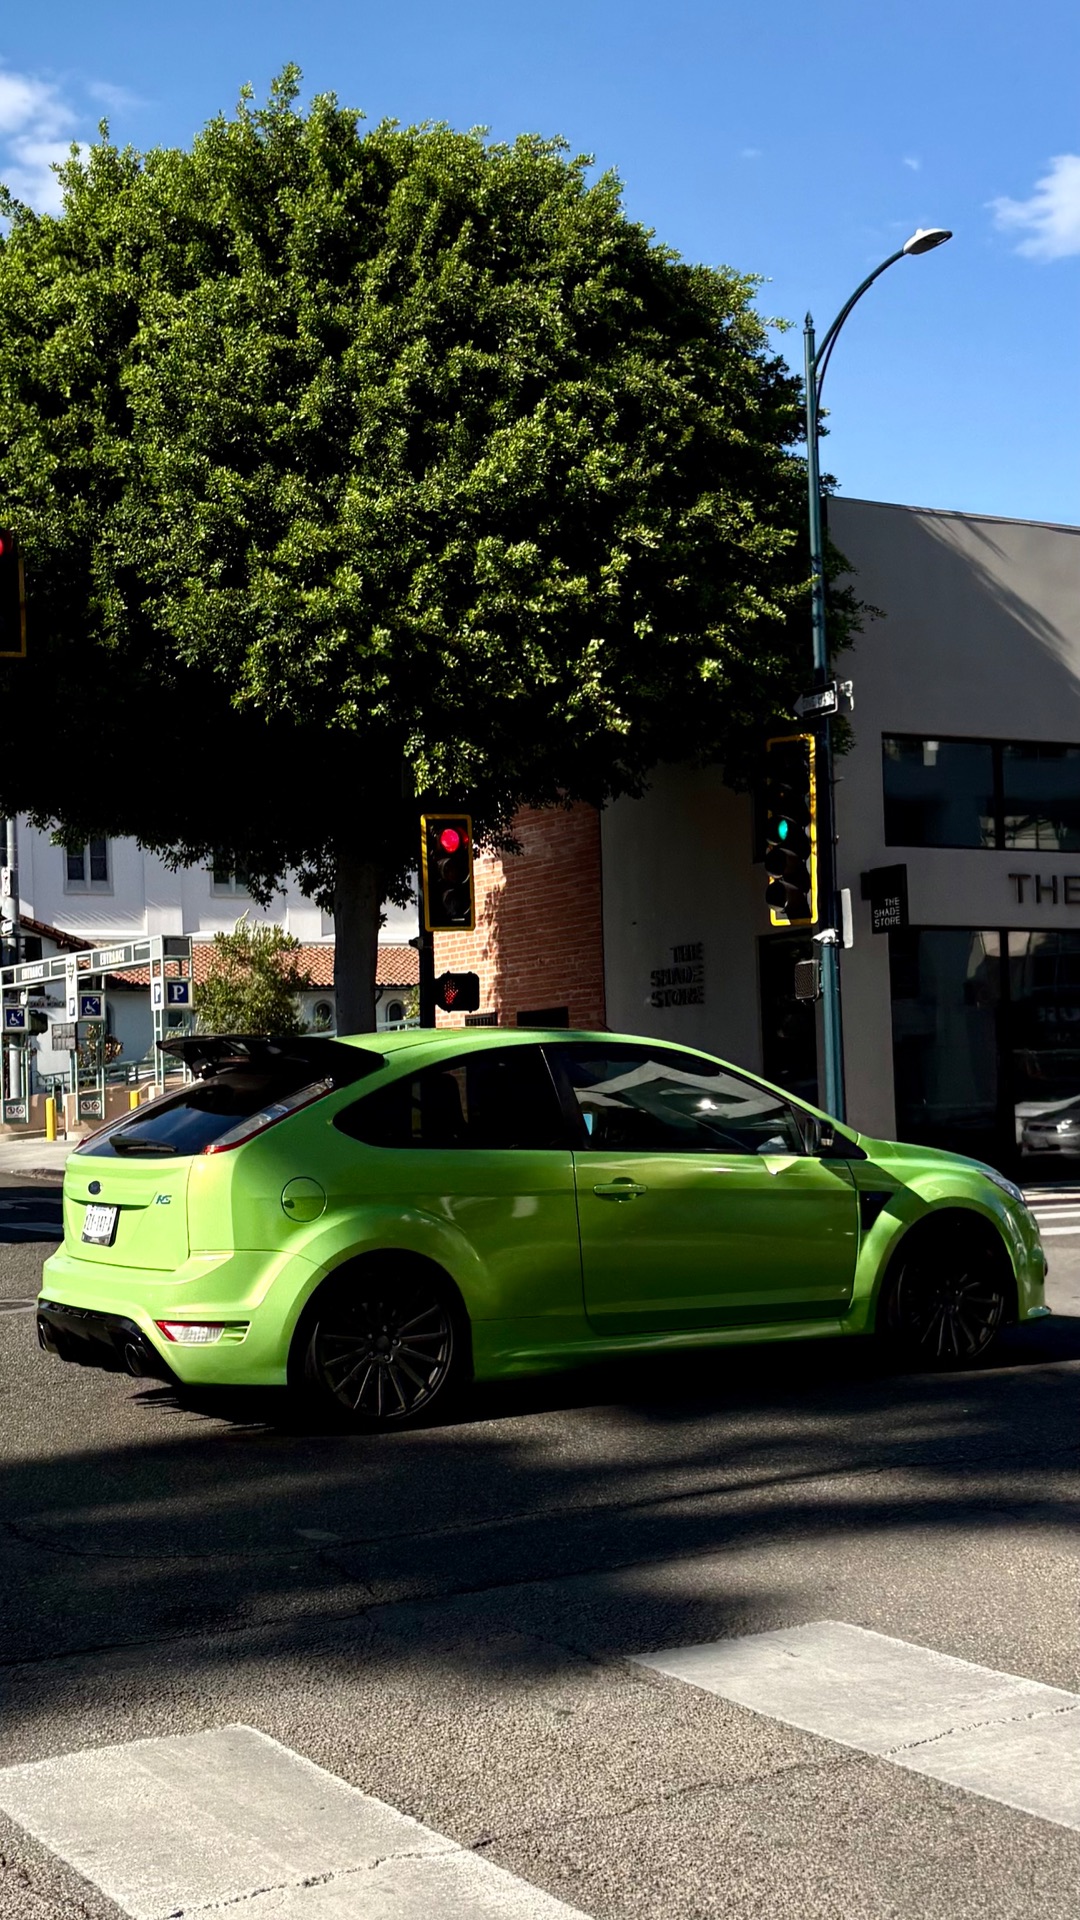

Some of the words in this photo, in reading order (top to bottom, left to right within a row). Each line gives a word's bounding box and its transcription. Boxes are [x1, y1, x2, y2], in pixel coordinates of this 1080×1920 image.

[1008, 873, 1080, 904] THE
[884, 896, 900, 906] THE
[873, 906, 900, 918] SHADE
[874, 915, 901, 928] STORE
[100, 949, 125, 966] ENTRANCE
[669, 942, 703, 963] THE
[21, 964, 44, 981] ENTRANCE
[650, 965, 704, 987] SHADE
[172, 984, 185, 1001] P
[650, 986, 705, 1008] STORE
